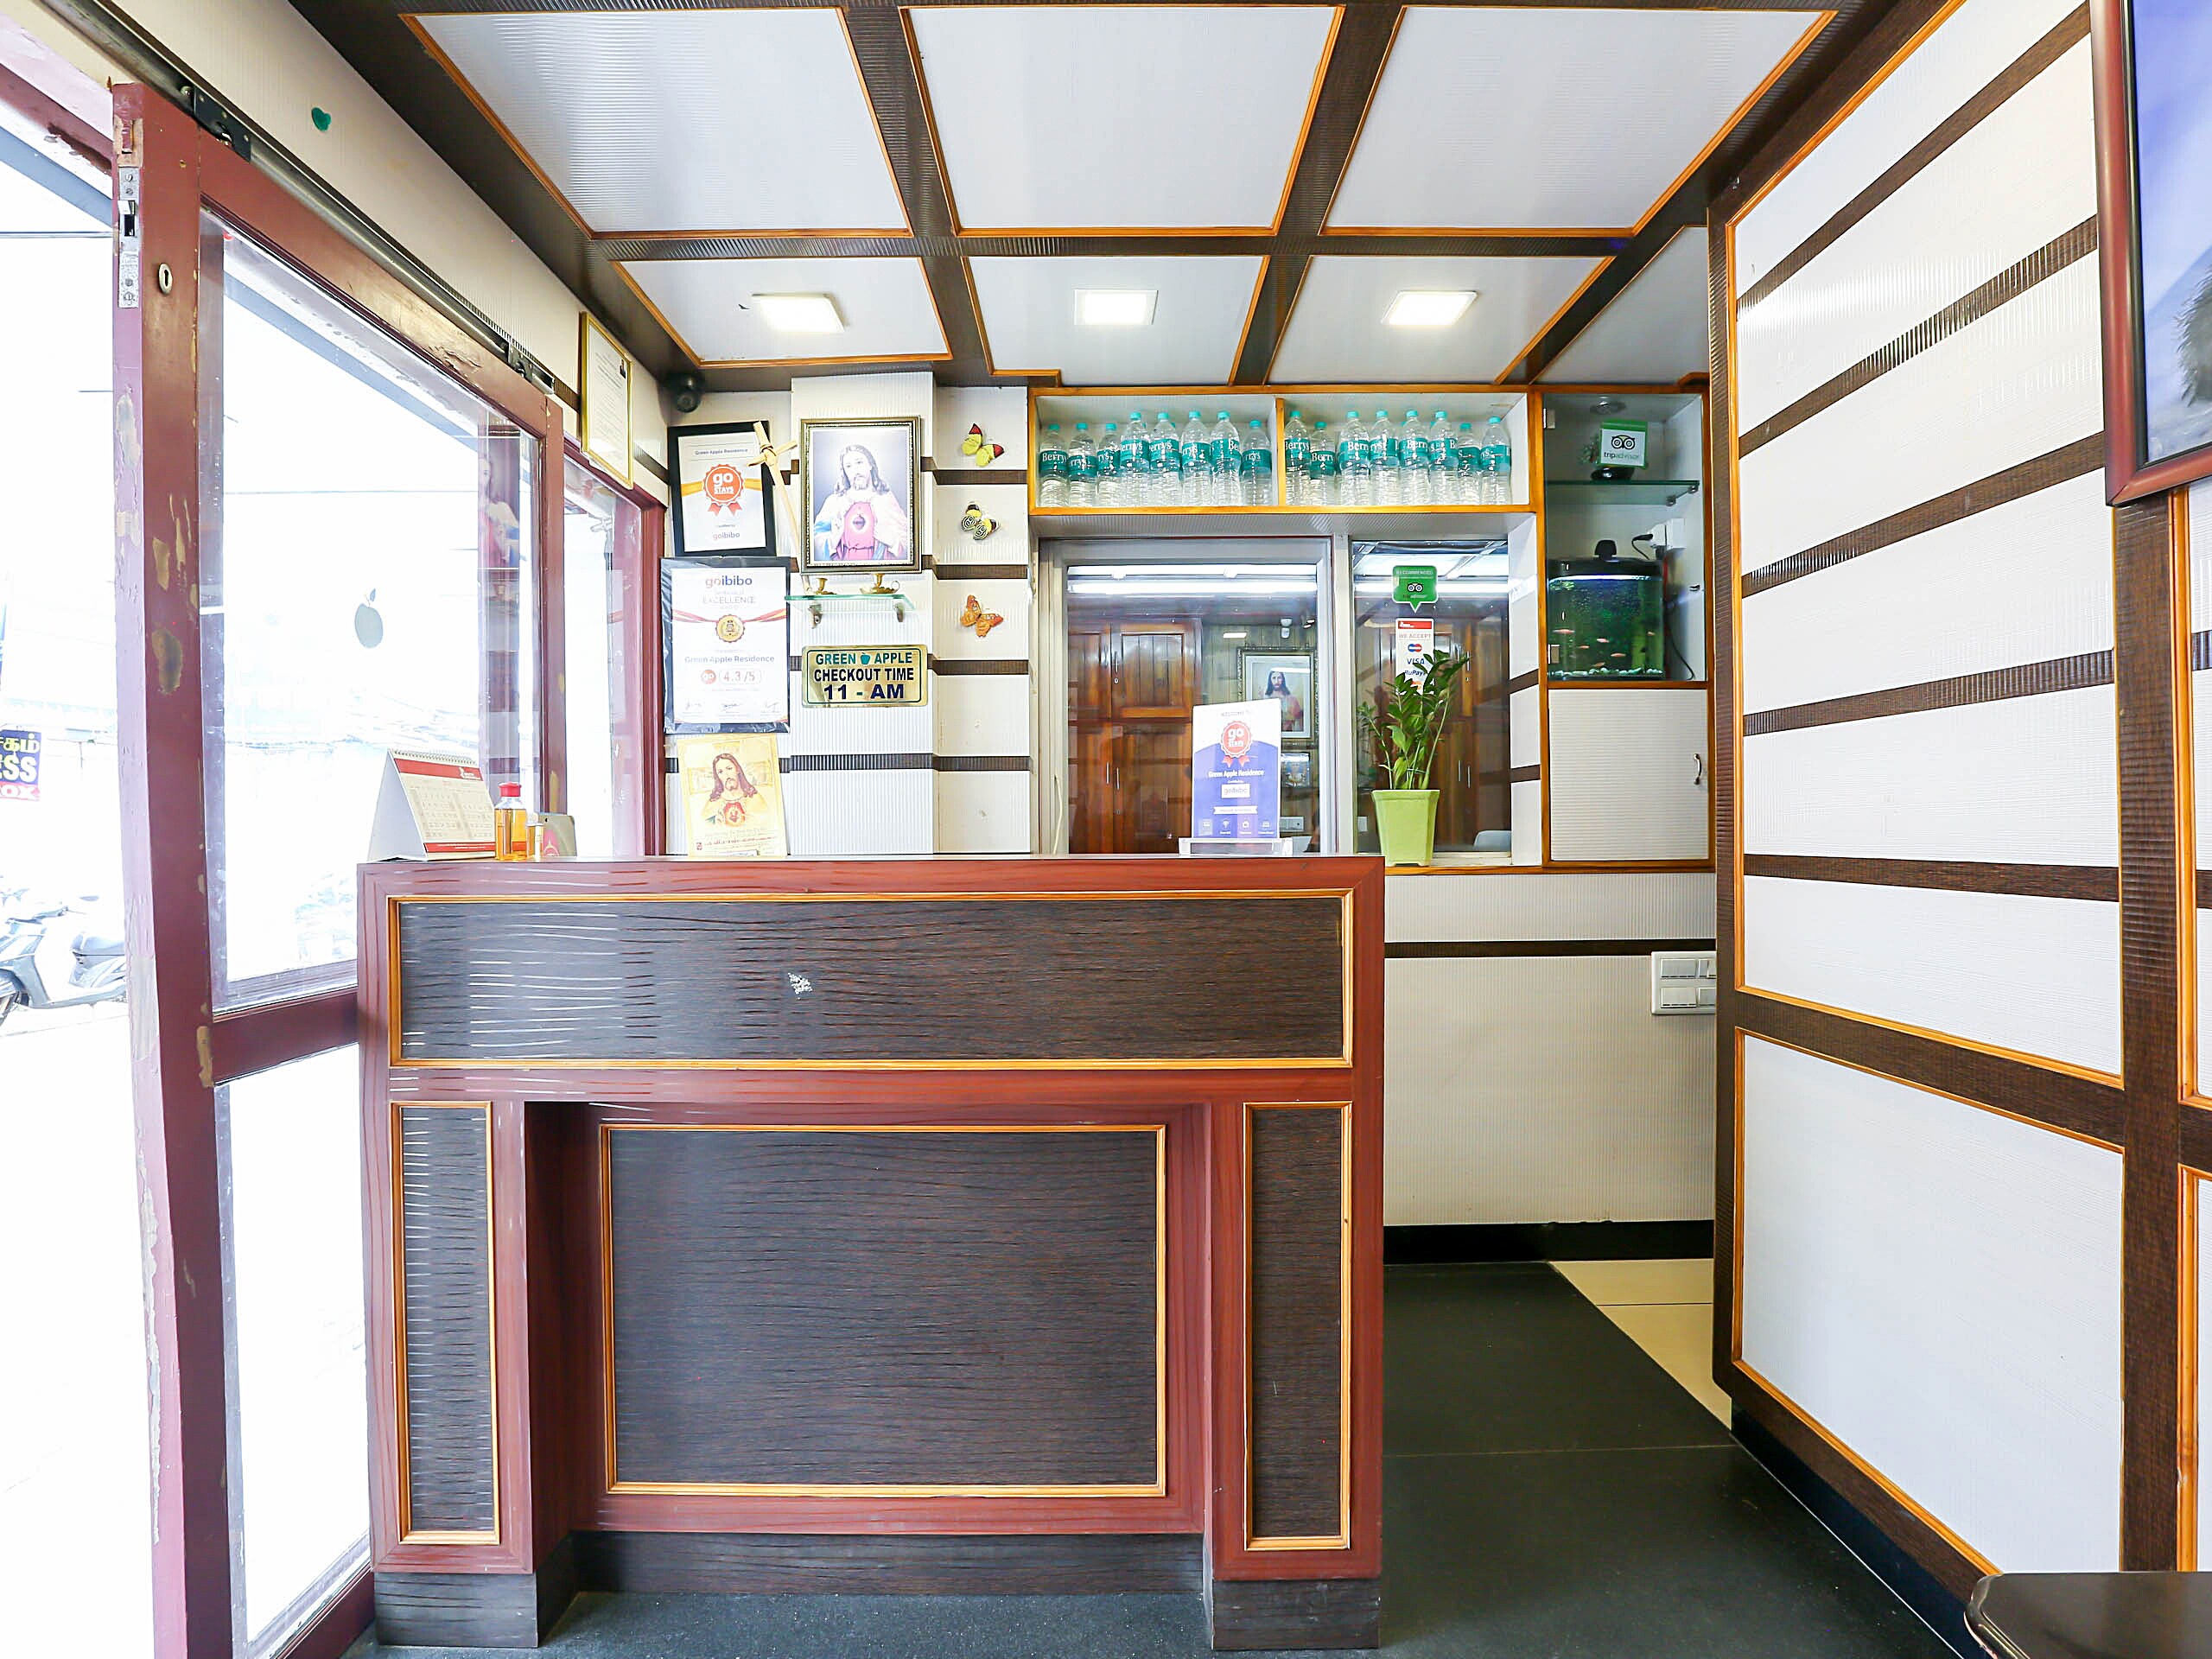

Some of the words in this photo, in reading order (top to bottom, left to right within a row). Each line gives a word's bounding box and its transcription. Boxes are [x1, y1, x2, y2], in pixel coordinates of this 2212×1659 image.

[1150, 440, 1173, 453] errys
[712, 473, 734, 486] go
[713, 531, 741, 541] goibibo
[705, 575, 753, 588] goibibo
[816, 653, 856, 665] GREEN
[874, 652, 912, 664] APPLE
[814, 668, 880, 682] CHECKOUT
[884, 667, 914, 681] TIME
[823, 684, 847, 700] 11
[870, 683, 904, 699] AM
[0, 733, 40, 753] கம்
